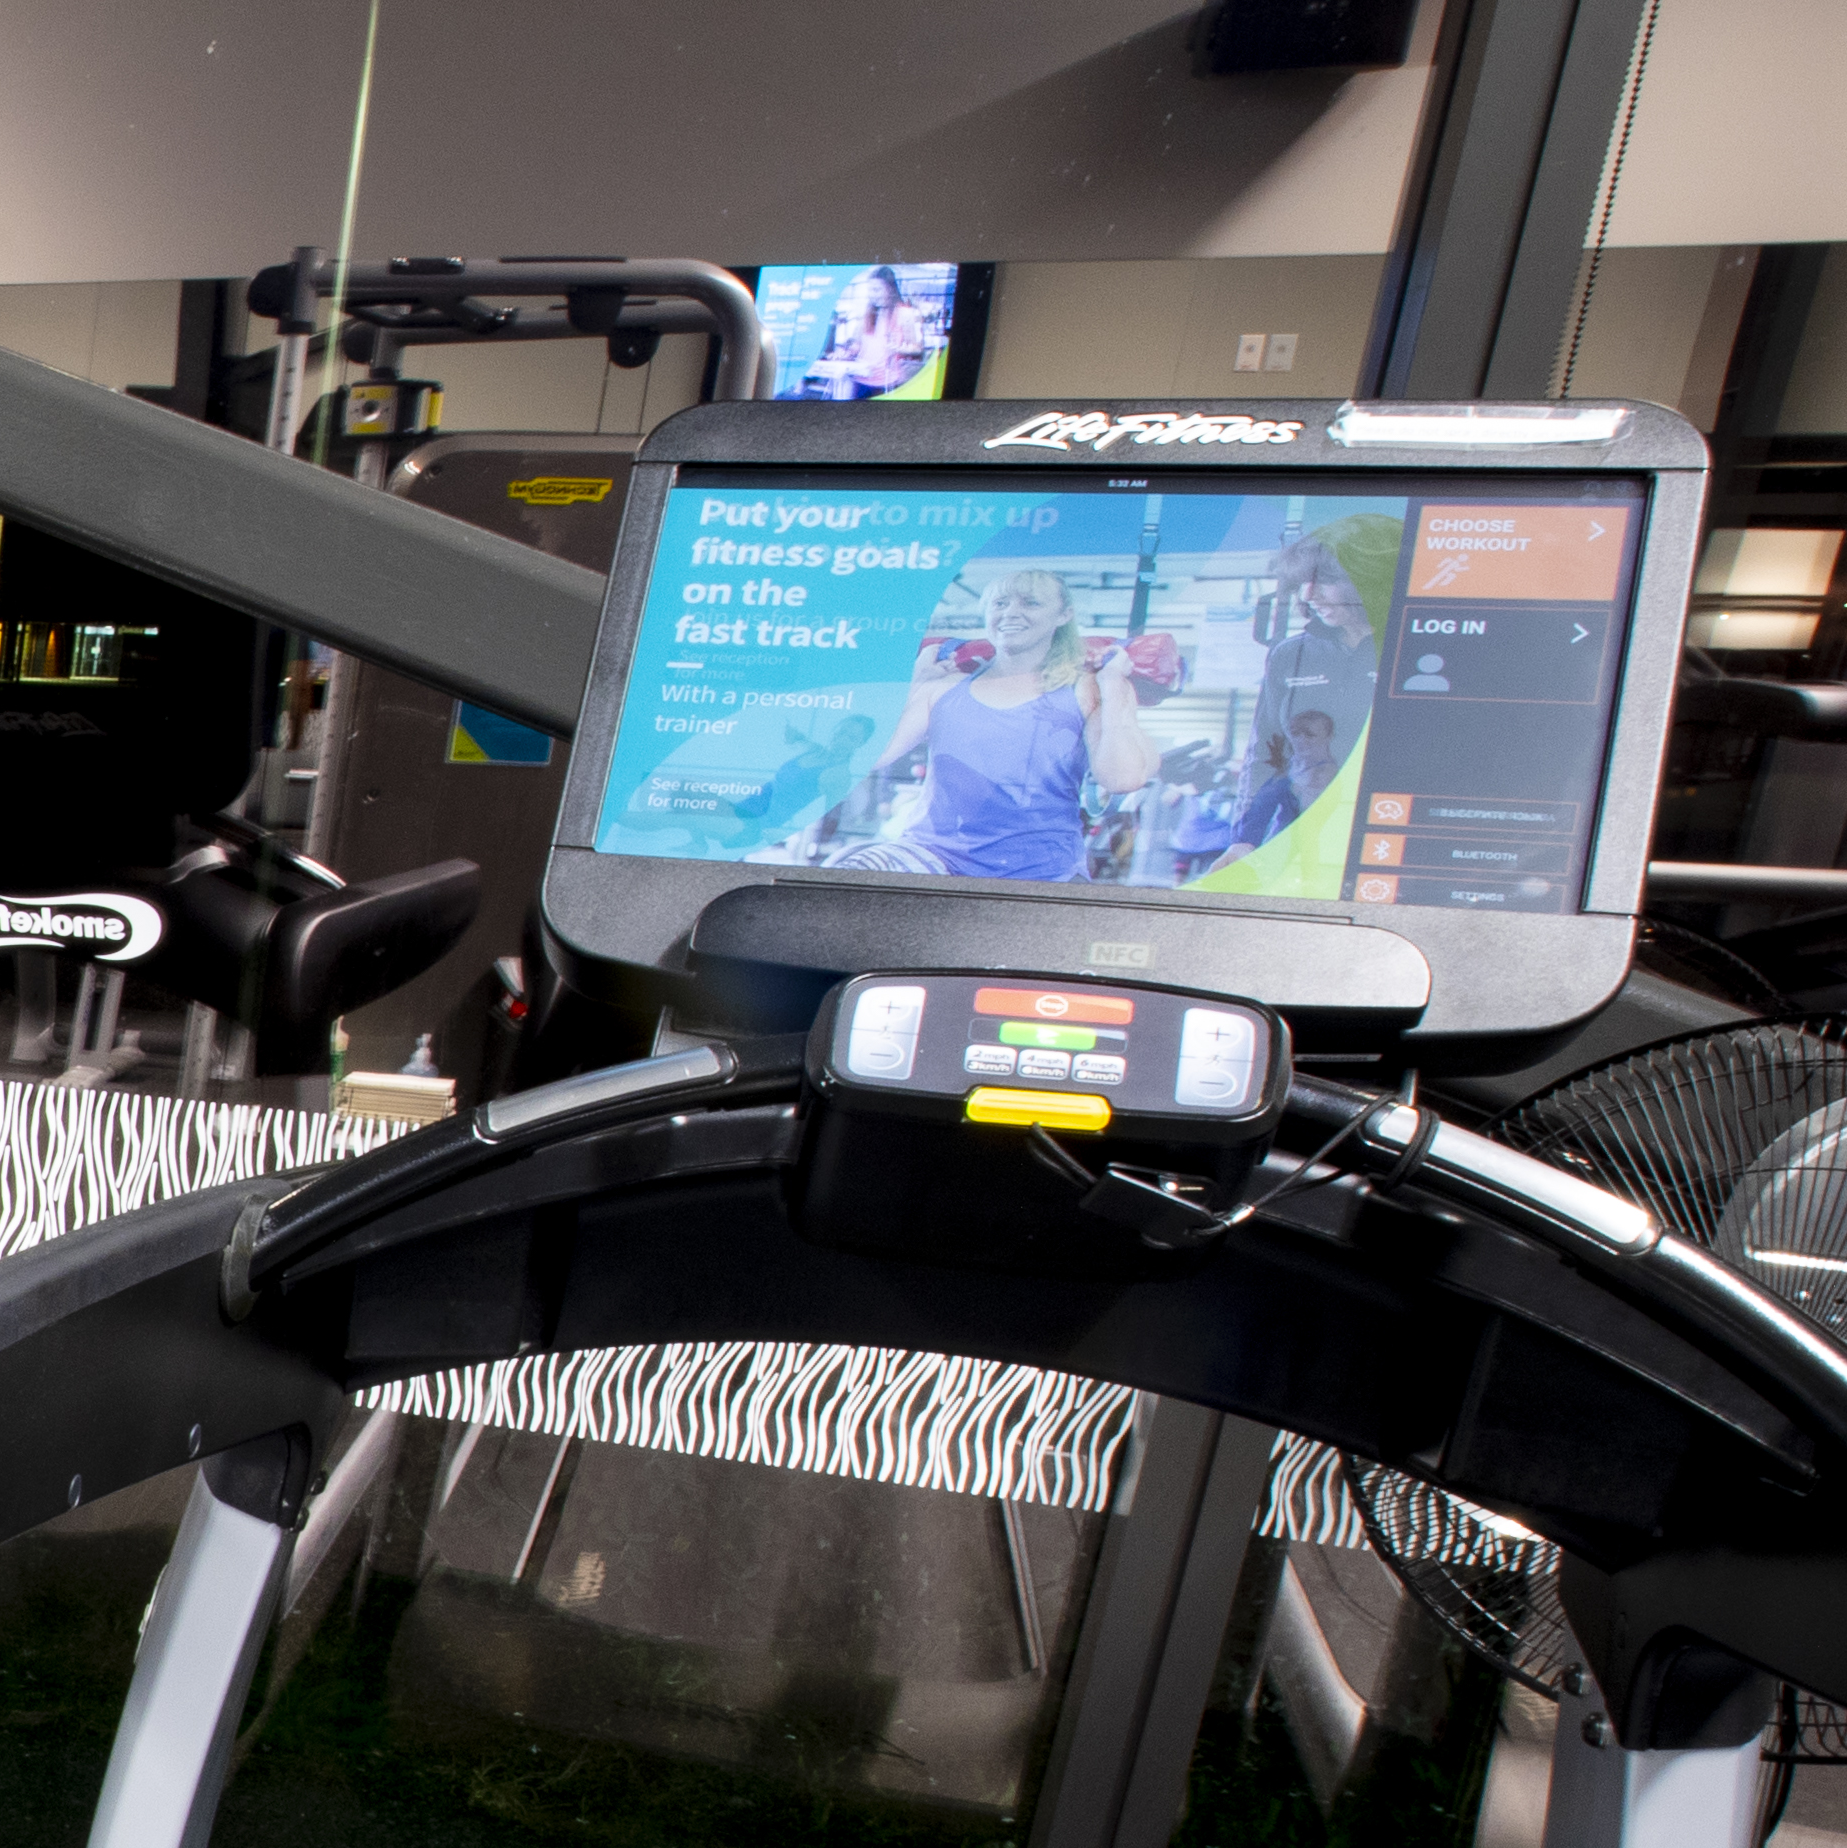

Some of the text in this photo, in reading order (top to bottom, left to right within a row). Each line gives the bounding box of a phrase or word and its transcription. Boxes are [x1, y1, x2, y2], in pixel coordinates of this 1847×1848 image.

[983, 411, 1304, 450] Life Fitness
[700, 499, 871, 534] Put your
[1429, 518, 1516, 533] CHOOSE
[1426, 536, 1532, 551] WORKOUT
[691, 537, 940, 575] fitness goals
[682, 578, 806, 607] on the
[674, 615, 861, 650] fast track
[1410, 618, 1487, 636] LOG IN
[660, 684, 854, 711] With a personal
[654, 714, 738, 735] trainer
[650, 777, 763, 798] See reception
[647, 794, 718, 812] for more
[1451, 850, 1518, 861] BLUETOOTH
[1093, 946, 1146, 963] NFC
